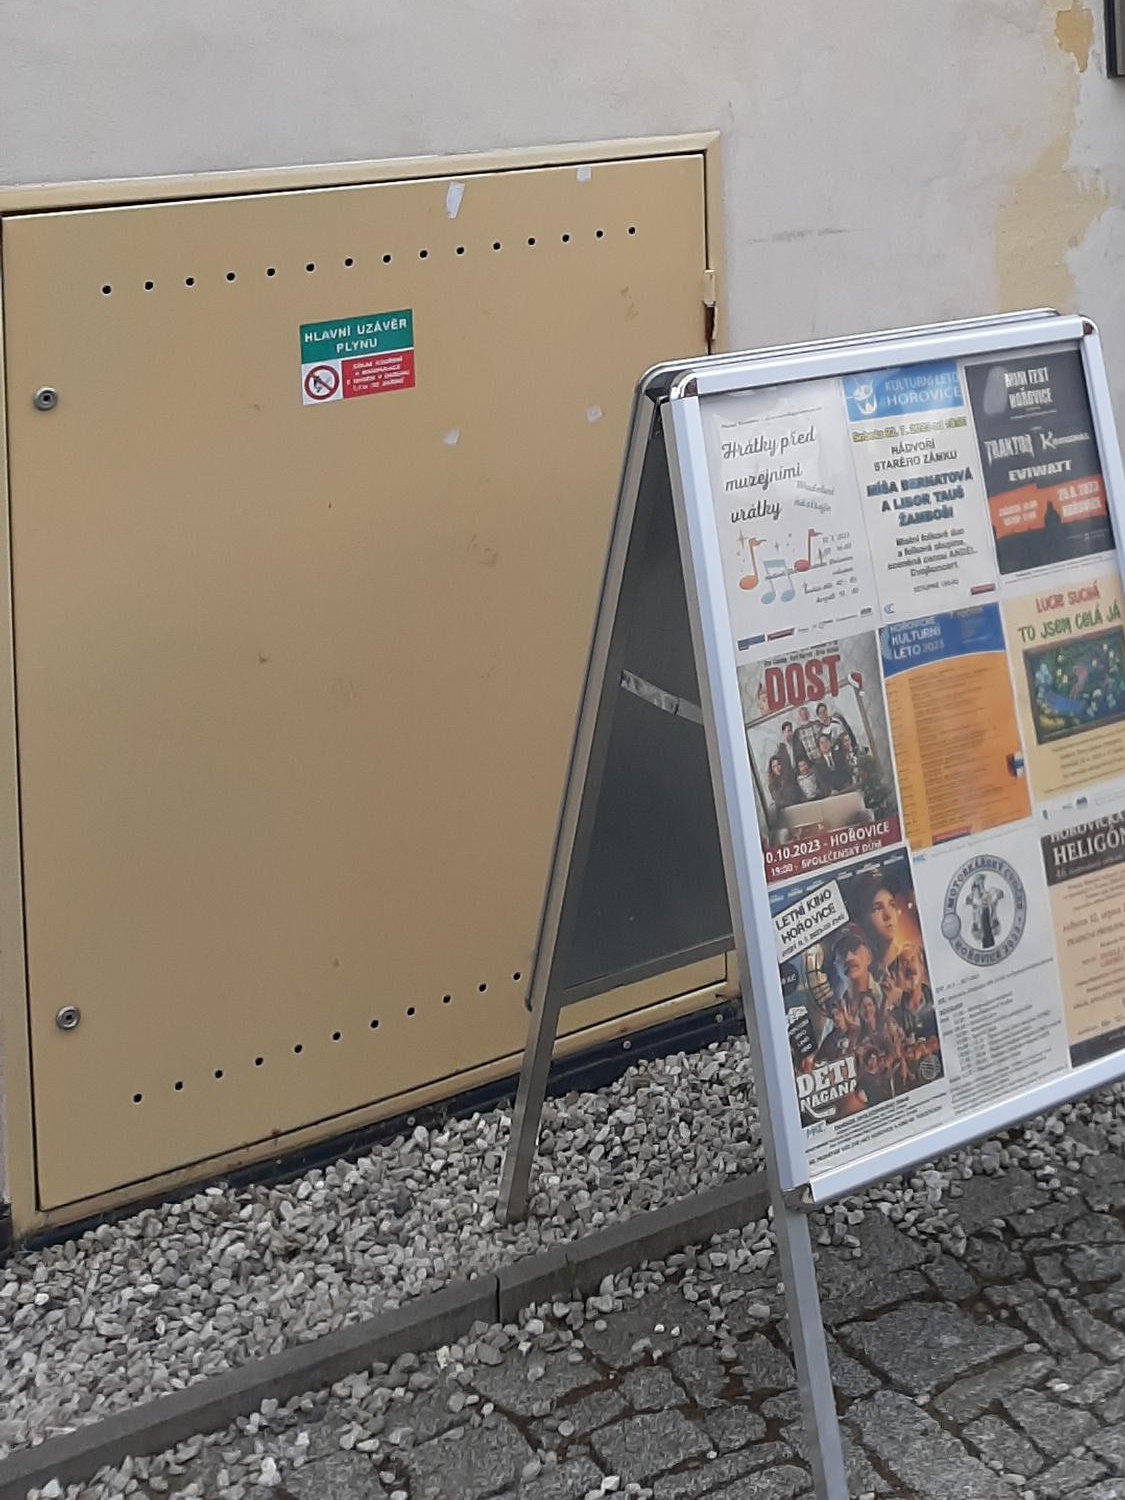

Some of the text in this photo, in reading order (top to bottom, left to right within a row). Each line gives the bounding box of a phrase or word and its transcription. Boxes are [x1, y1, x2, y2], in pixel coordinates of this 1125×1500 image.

[304, 318, 407, 342] HLAVNÍ UZÁVĚR
[336, 338, 377, 353] PLYNU
[721, 426, 816, 459] Hrátky před
[725, 462, 802, 491] muzejními
[731, 500, 782, 523] vrátky
[892, 622, 942, 646] KULTURNÍ
[1017, 625, 1036, 643] TO
[893, 643, 921, 660] LÉTO
[764, 654, 841, 712] DOST
[830, 821, 890, 848] HOŘOVICE
[775, 888, 832, 931] LETNÍ KINO
[797, 1056, 857, 1098] DĚTI
